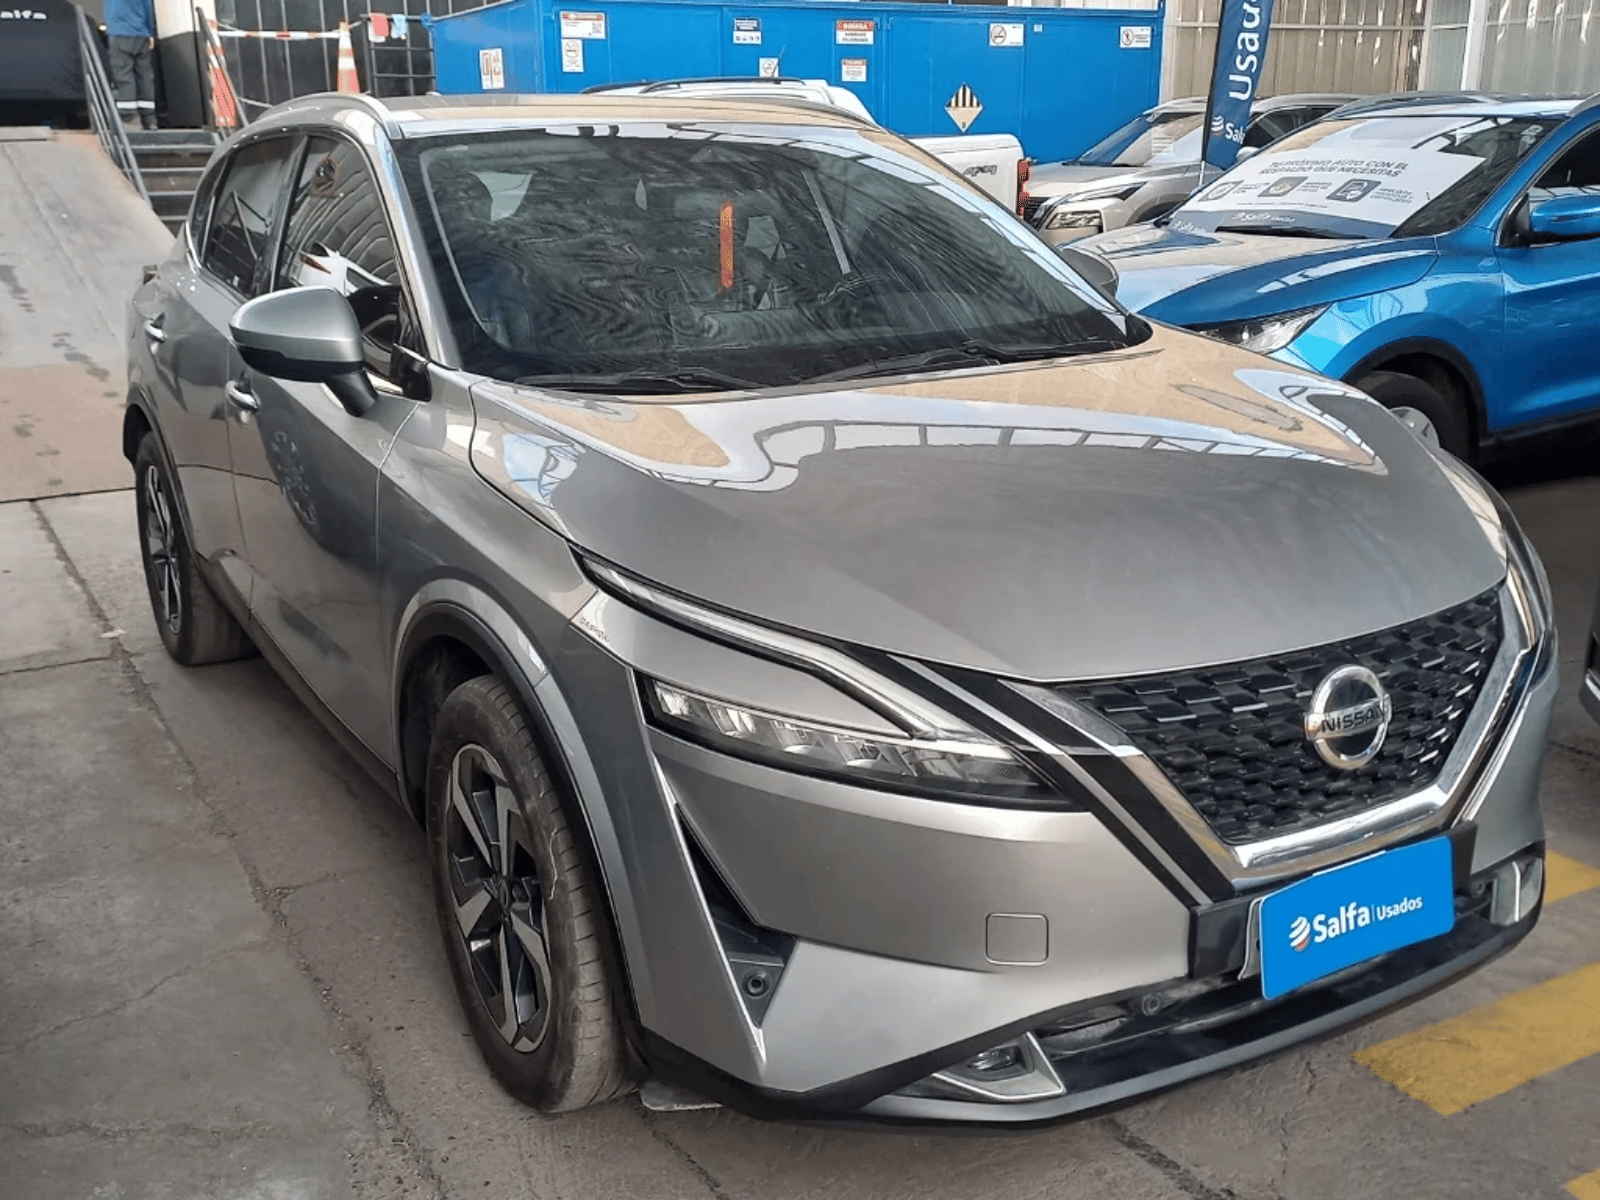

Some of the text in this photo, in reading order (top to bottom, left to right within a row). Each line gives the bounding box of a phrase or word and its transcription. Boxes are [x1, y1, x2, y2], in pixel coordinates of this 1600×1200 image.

[1321, 700, 1384, 734] NISSAN
[1312, 896, 1422, 943] Salfa Usados
